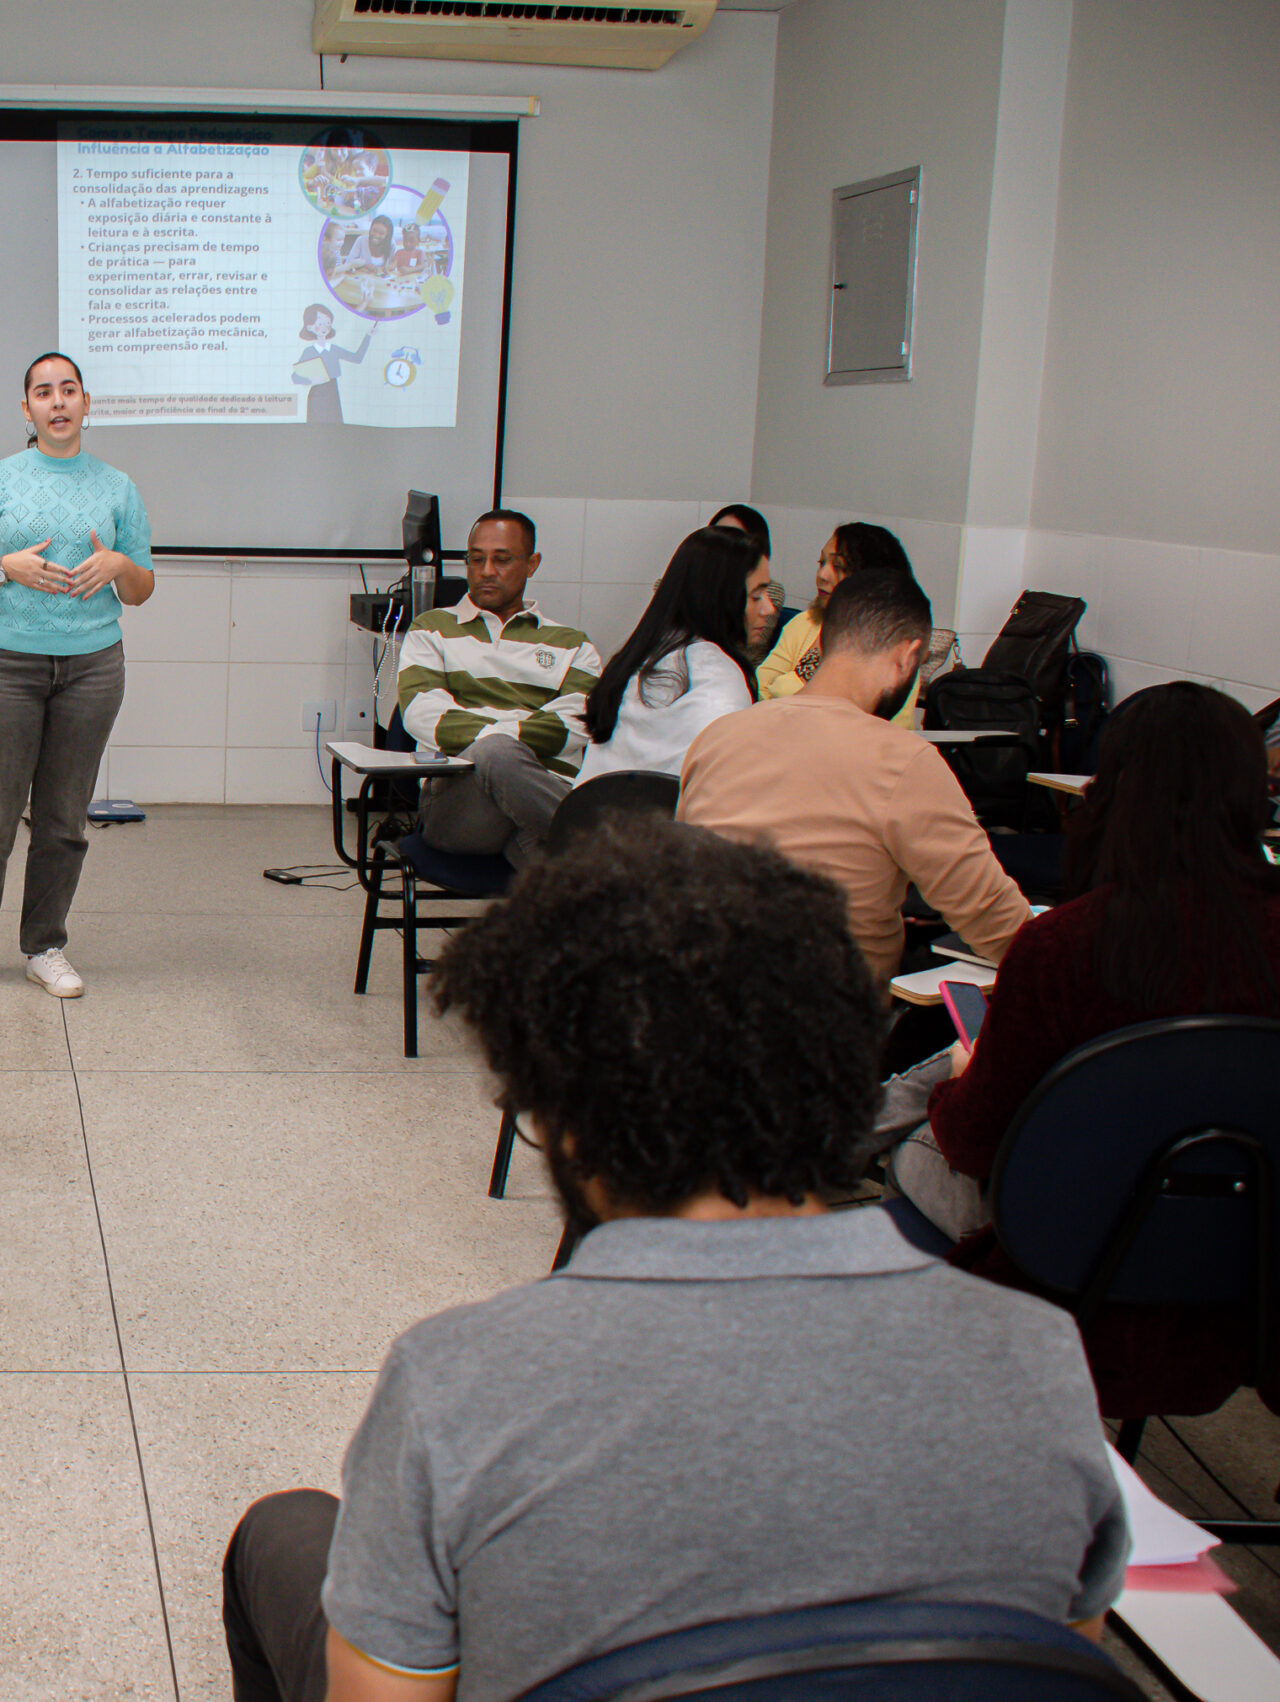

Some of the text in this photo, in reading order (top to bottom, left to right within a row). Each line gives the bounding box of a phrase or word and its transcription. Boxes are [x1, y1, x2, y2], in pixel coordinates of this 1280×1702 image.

[78, 142, 149, 155] Influência
[154, 146, 163, 155] a
[73, 169, 83, 179] 2.
[87, 169, 128, 182] Tempo
[131, 168, 192, 179] suficiente
[195, 171, 222, 182] para
[73, 184, 269, 197] consolidação das aprendizagens
[88, 199, 226, 211] A alfabetização requer
[88, 213, 271, 225] exposição diária e constante à
[88, 227, 198, 238] leitura e à escrita.
[88, 242, 260, 254] Crianças precisam de tempo
[88, 257, 103, 267] de
[106, 256, 150, 269] prática
[168, 257, 196, 268] para
[88, 271, 268, 284] experimentar, errar, revisar e
[88, 285, 257, 297] consolidar as relações entre
[88, 300, 170, 310] fala e escrita.
[88, 313, 261, 325] Processos acelerados podem
[88, 327, 268, 341] gerar alfabetização mecânica,
[88, 341, 228, 354] sem compreensão real.
